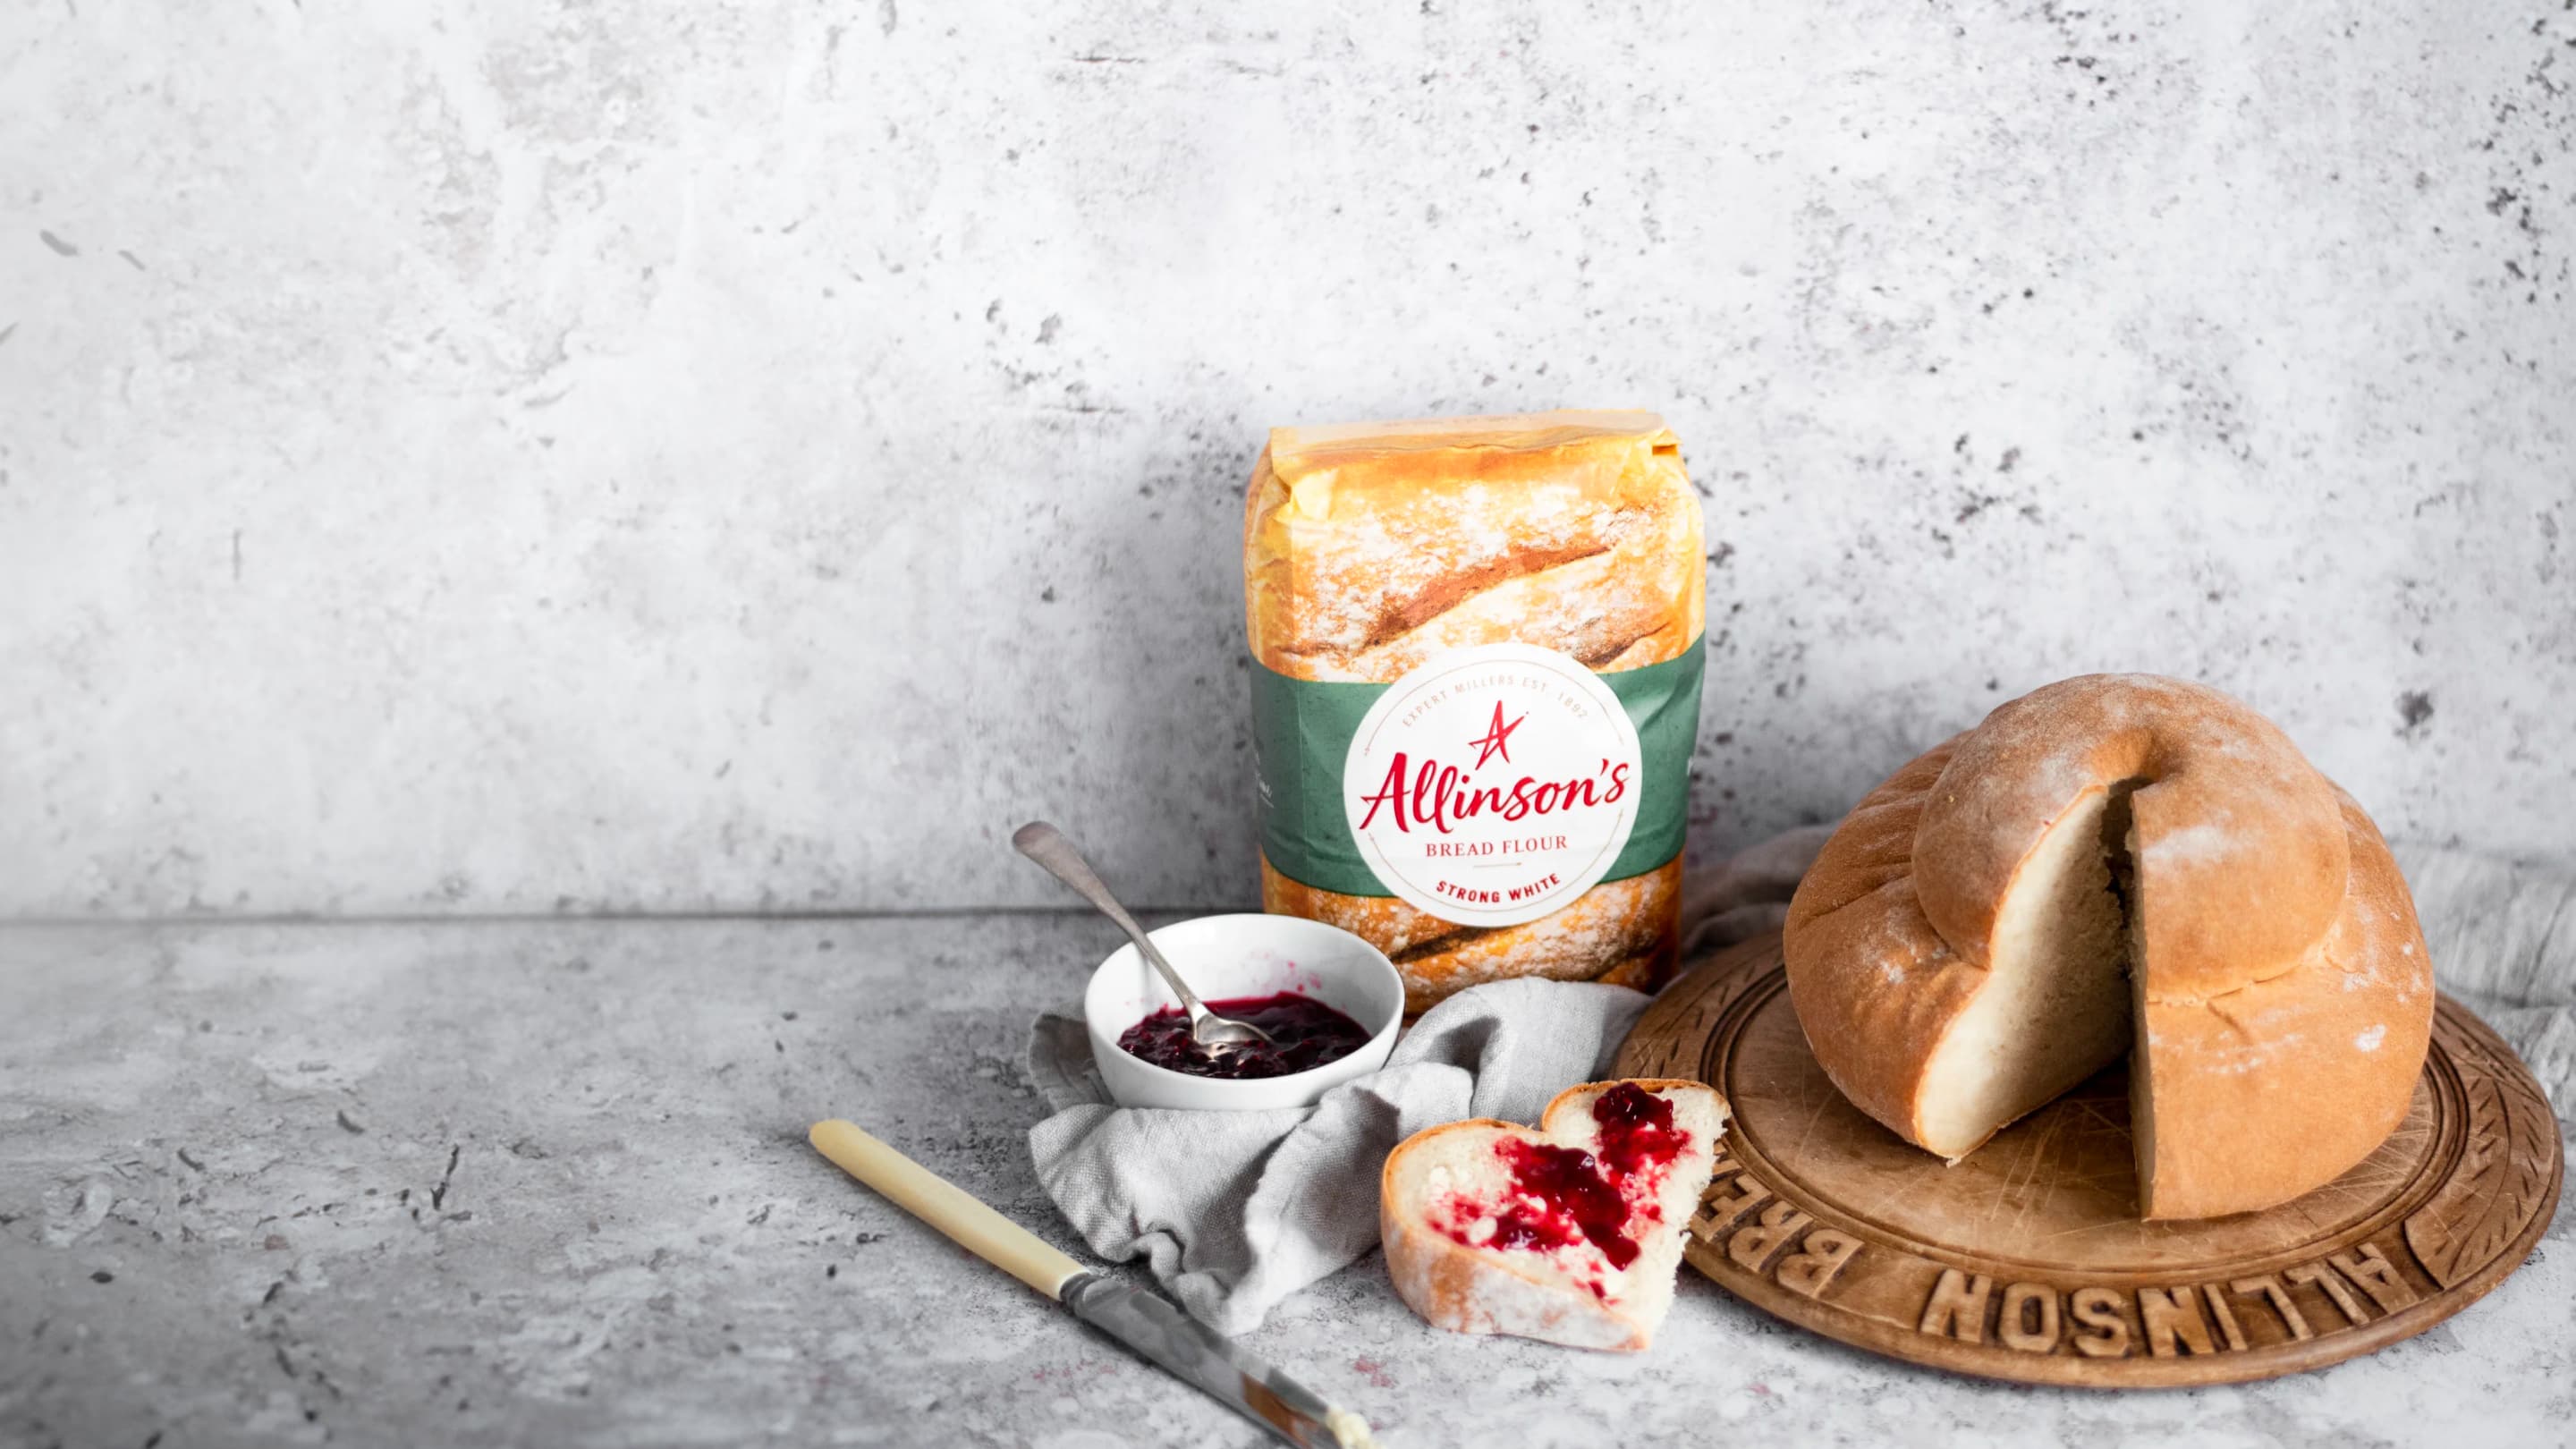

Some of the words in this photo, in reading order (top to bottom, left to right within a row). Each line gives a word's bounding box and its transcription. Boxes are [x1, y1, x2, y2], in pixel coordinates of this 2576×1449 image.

[1402, 691, 1447, 727] EXPERT
[1454, 674, 1514, 693] MILLERS
[1557, 691, 1589, 718] 1892
[1360, 752, 1629, 834] Allinson's
[1426, 843, 1495, 858] BREAD
[1503, 836, 1567, 854] FLOUR
[1436, 881, 1500, 903] STRONG
[1509, 874, 1560, 901] WHITE
[1920, 1242, 2416, 1357] ALLINSON
